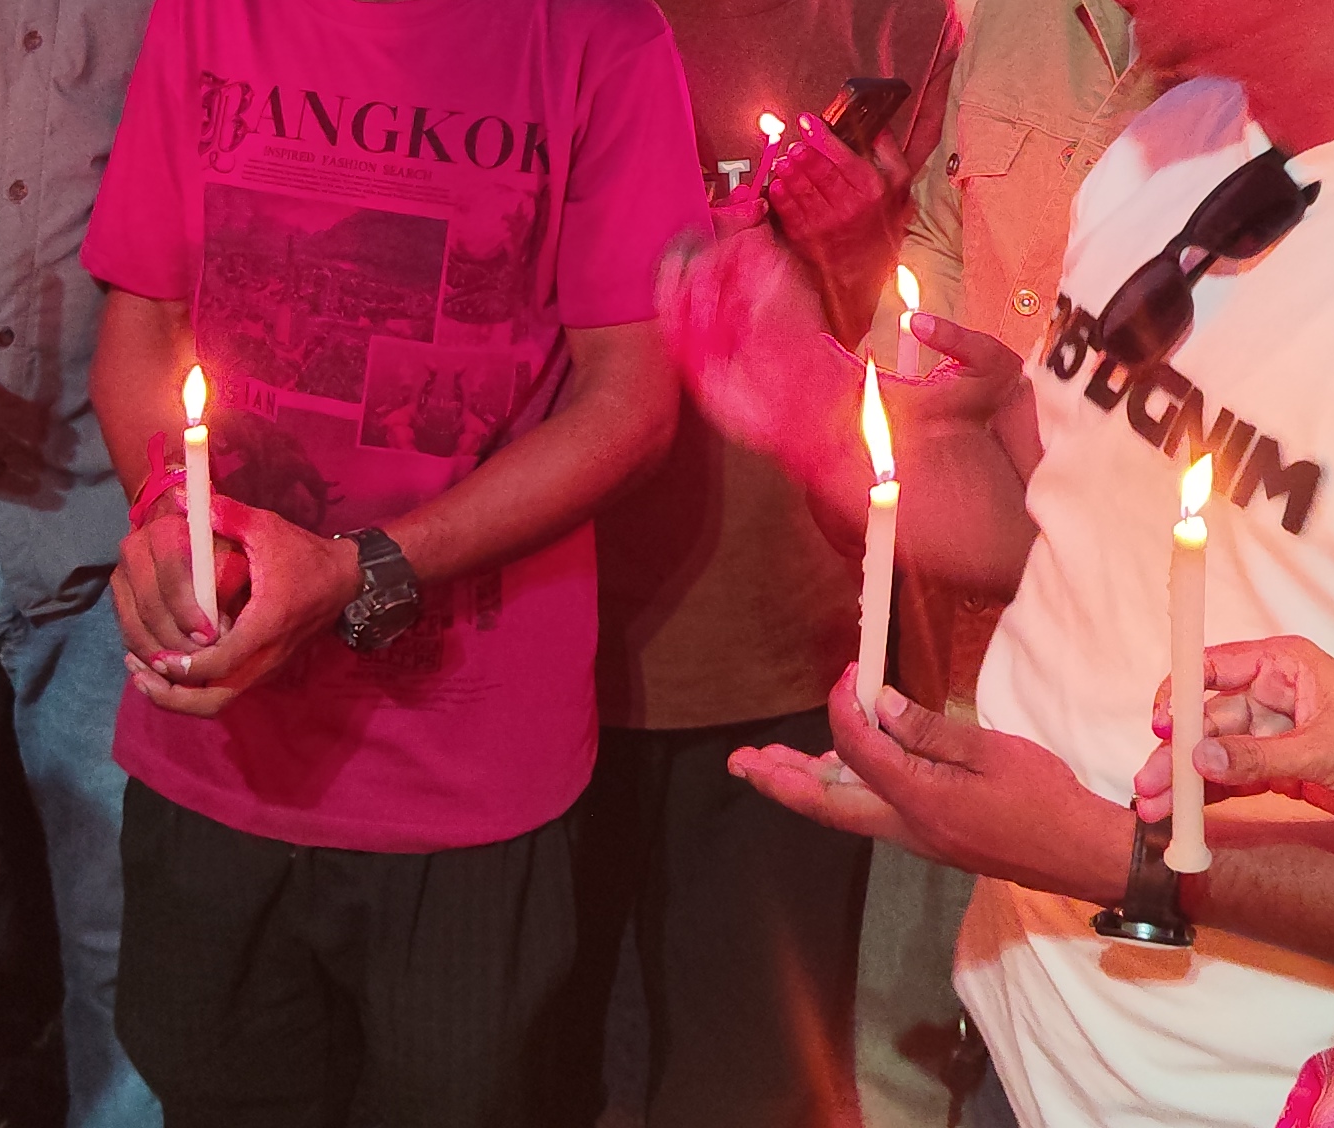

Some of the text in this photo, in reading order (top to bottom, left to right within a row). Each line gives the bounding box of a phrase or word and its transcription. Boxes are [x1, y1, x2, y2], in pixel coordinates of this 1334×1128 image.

[197, 70, 552, 175] BANGKOK
[263, 145, 315, 164] INSPIRED
[382, 164, 434, 181] SEARCH
